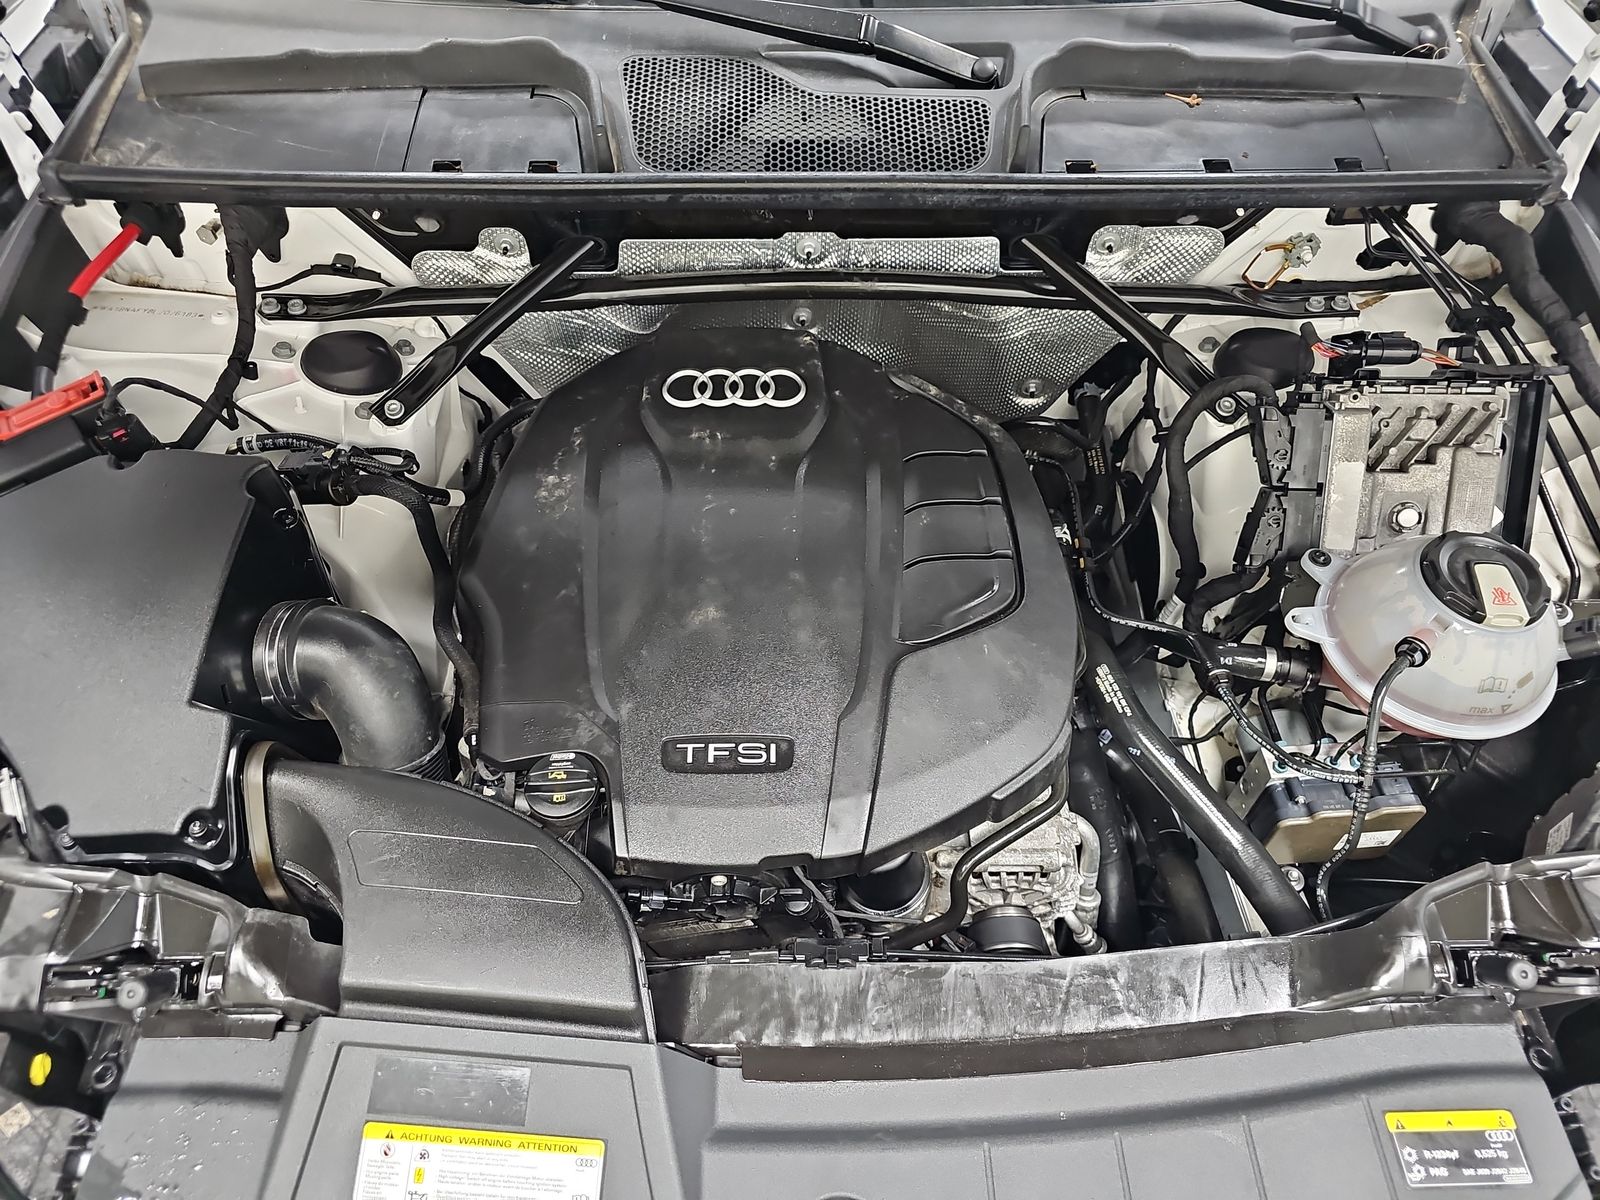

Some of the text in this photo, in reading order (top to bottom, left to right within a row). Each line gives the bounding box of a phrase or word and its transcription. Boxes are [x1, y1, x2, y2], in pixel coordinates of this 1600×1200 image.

[676, 743, 776, 764] TFSI
[400, 1132, 452, 1144] ACHTUNG
[458, 1138, 512, 1148] WARNING
[517, 1141, 578, 1153] ATTENTION
[1428, 1167, 1449, 1177] PAG
